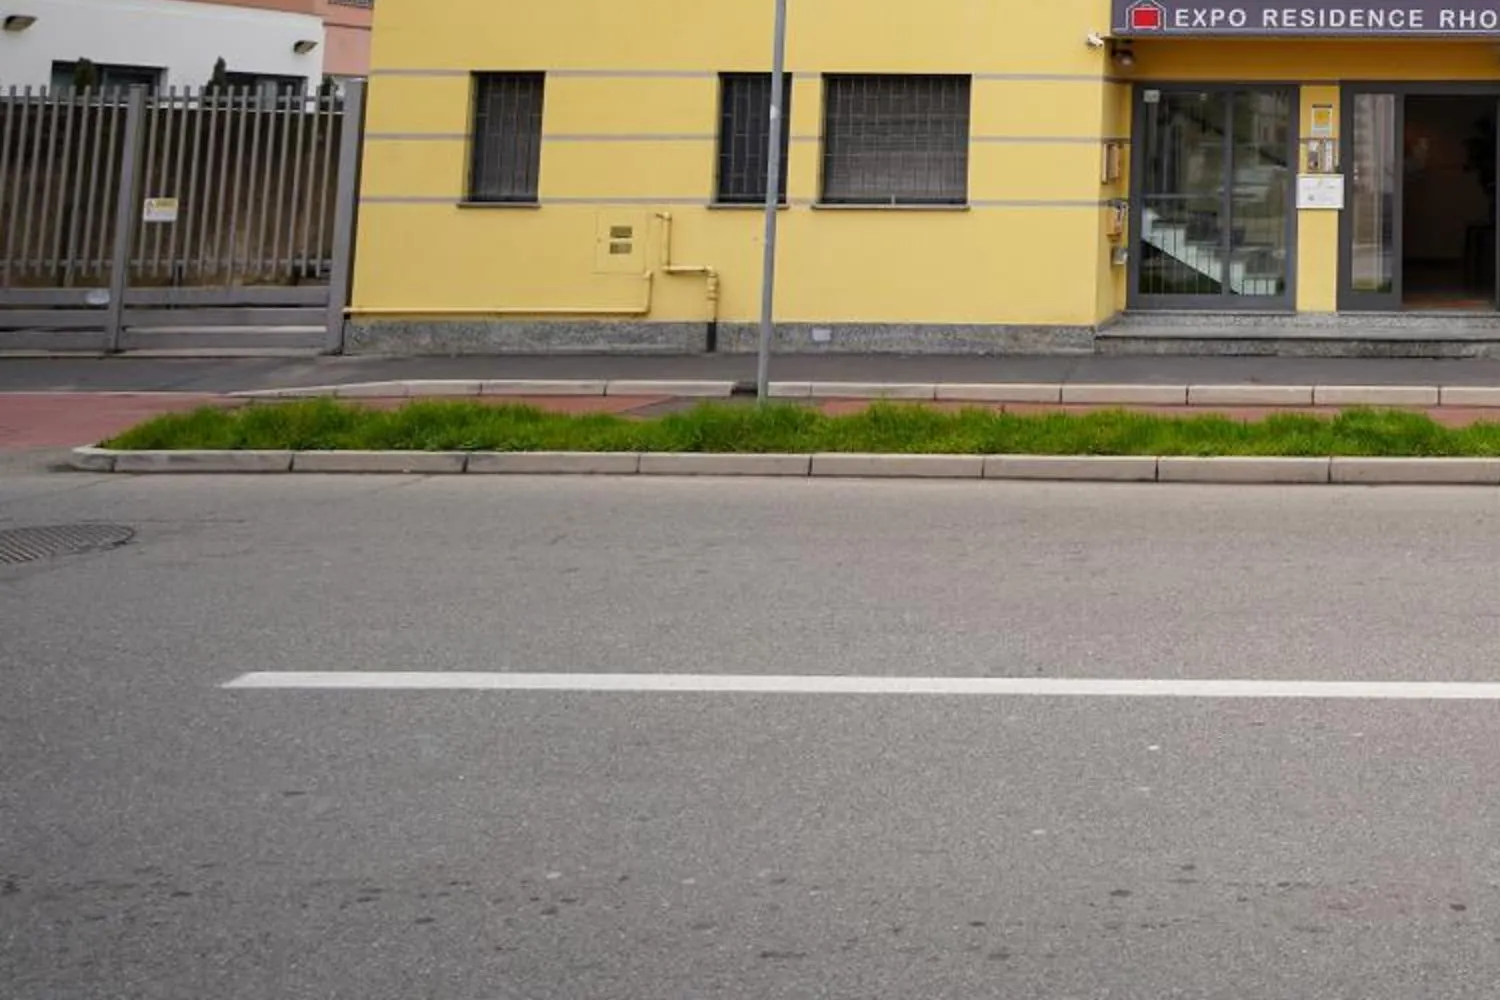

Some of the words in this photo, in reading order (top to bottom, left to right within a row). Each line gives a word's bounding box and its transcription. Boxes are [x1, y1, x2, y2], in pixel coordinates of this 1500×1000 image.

[1175, 8, 1247, 28] EXPO
[1262, 8, 1424, 28] RESIDENCE
[1439, 9, 1498, 29] RHO
